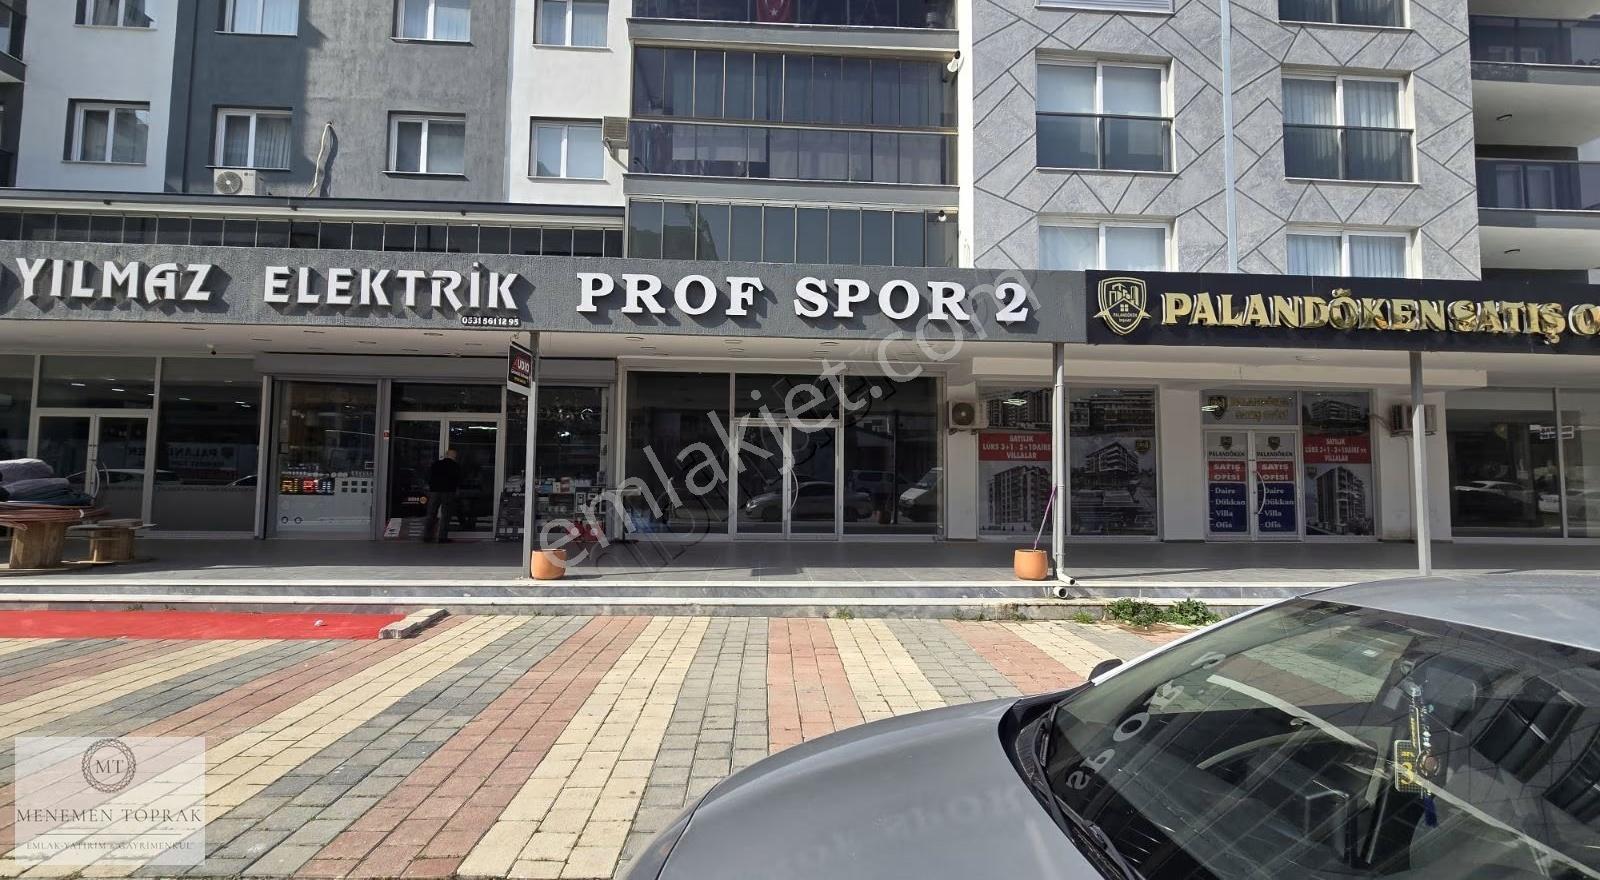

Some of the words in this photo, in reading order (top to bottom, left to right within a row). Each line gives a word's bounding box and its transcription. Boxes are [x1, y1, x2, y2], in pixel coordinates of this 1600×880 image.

[16, 257, 212, 304] YILMAZ
[264, 262, 518, 311] ELEKTRİK
[576, 272, 764, 316] PROF
[792, 277, 970, 321] SPOR
[995, 282, 1029, 322] 2
[1161, 287, 1446, 332] PALANDÖKEN
